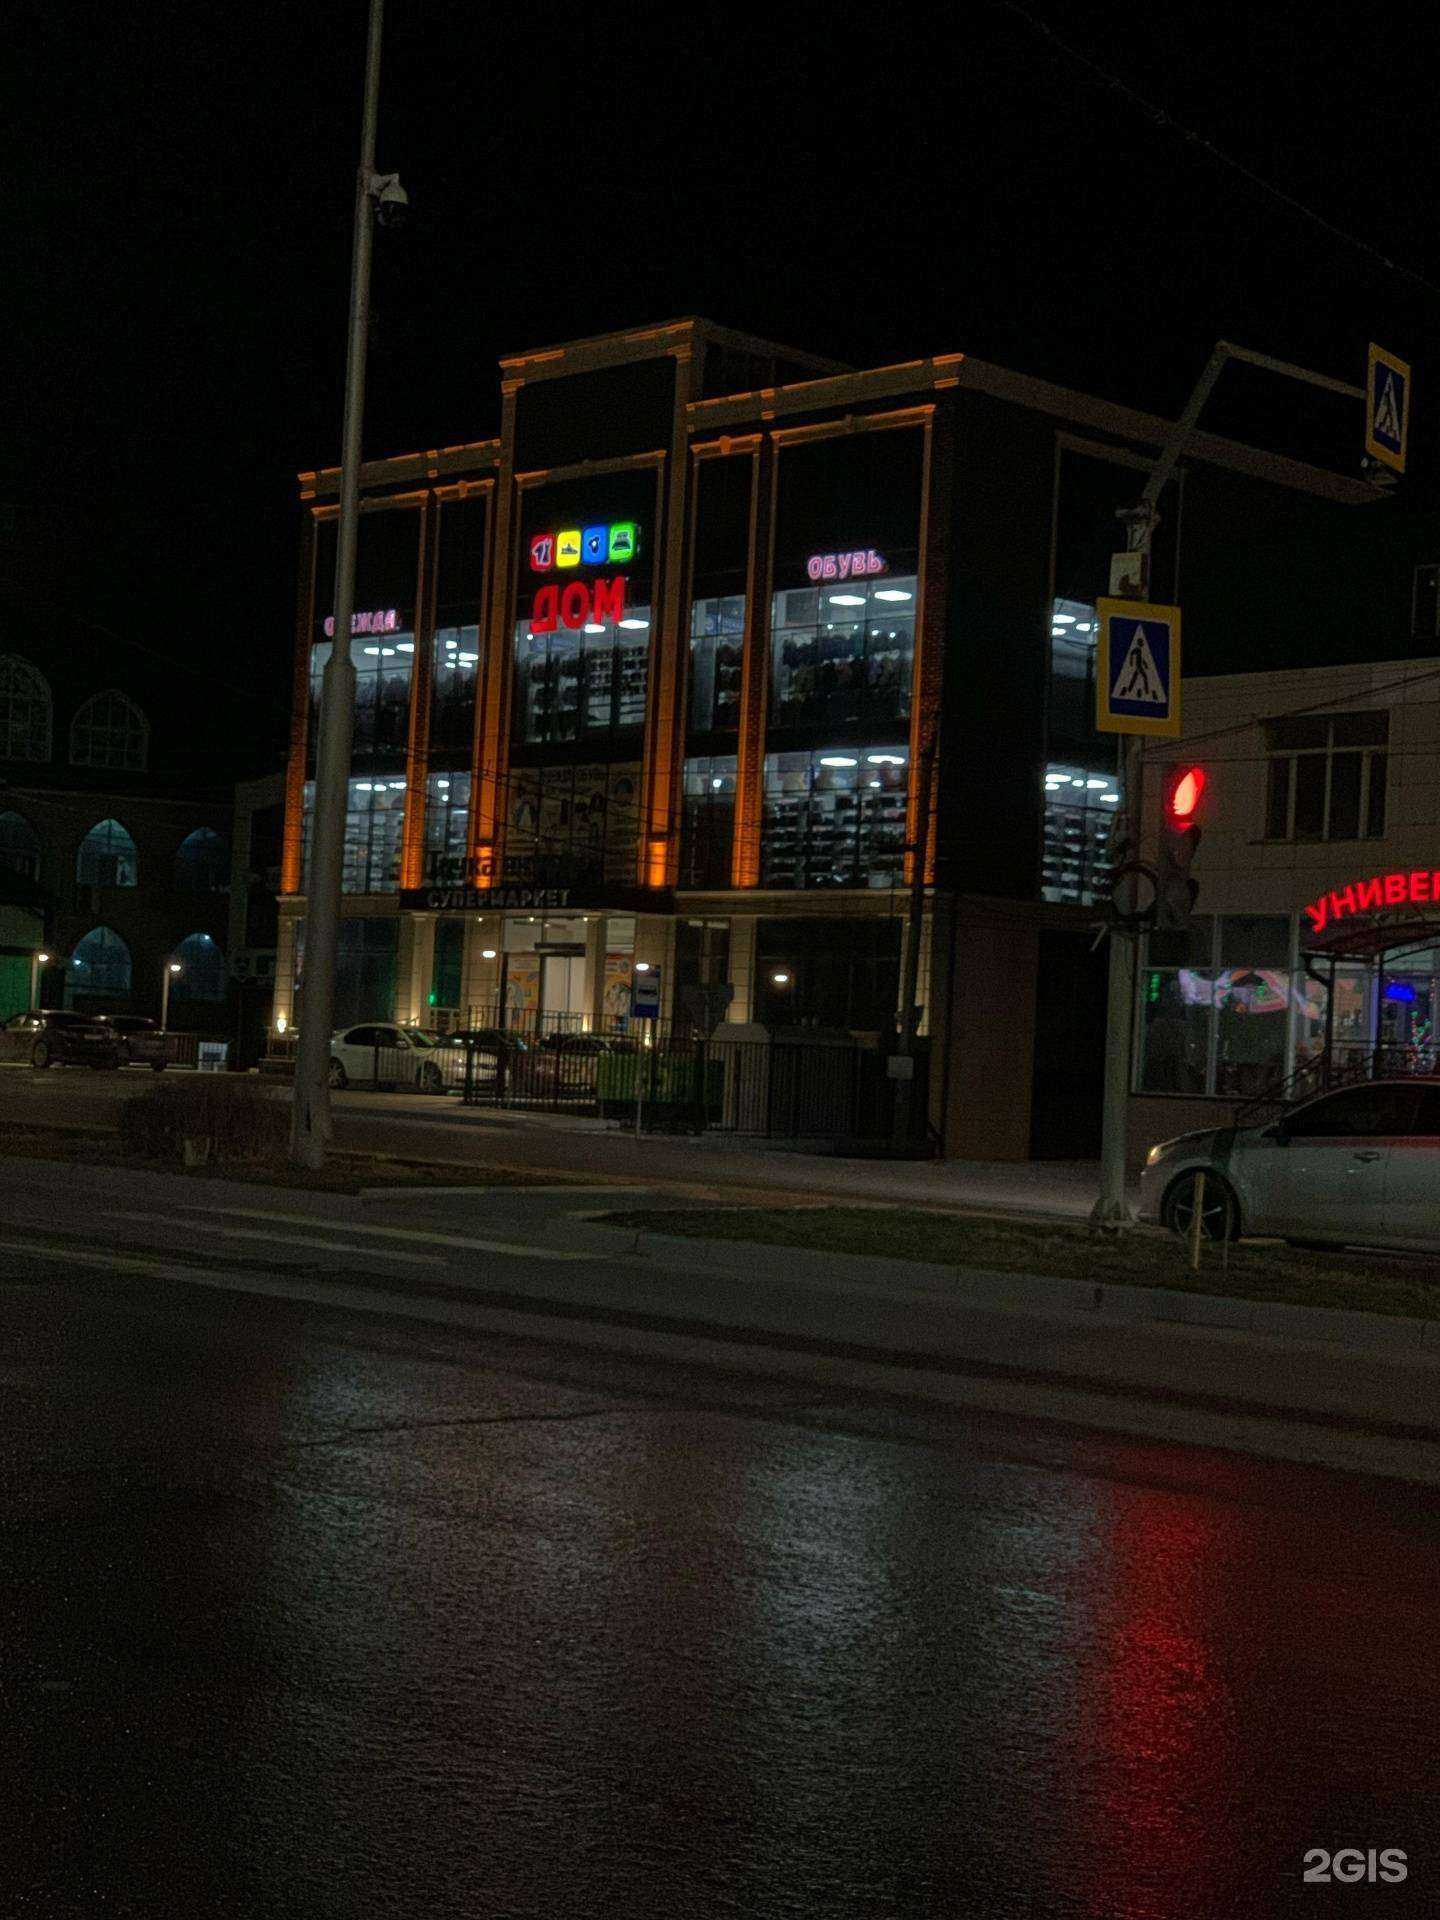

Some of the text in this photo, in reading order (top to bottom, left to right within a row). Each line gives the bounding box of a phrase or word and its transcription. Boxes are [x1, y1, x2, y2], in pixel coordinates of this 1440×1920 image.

[807, 548, 882, 580] ОБУВЬ
[530, 575, 626, 634] ДОМ
[426, 886, 570, 909] СУПЕРМАРКЕТ
